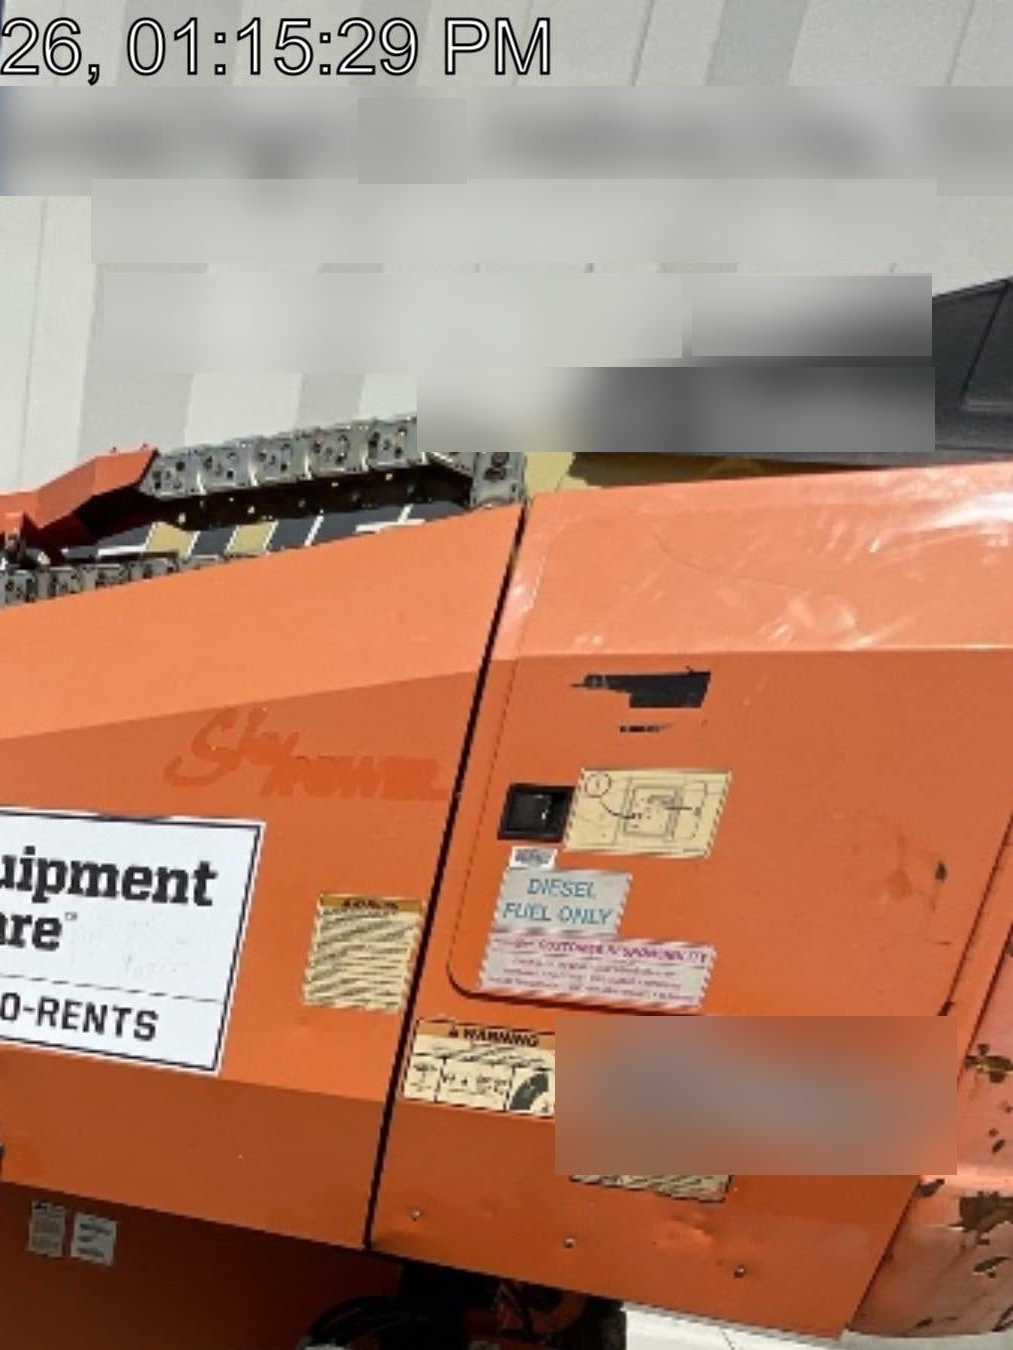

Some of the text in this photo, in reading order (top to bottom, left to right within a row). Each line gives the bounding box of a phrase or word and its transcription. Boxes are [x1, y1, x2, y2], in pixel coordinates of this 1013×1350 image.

[526, 878, 596, 898] DIESEL
[502, 902, 613, 925] FUEL ONLY
[463, 1027, 540, 1048] WARNING
